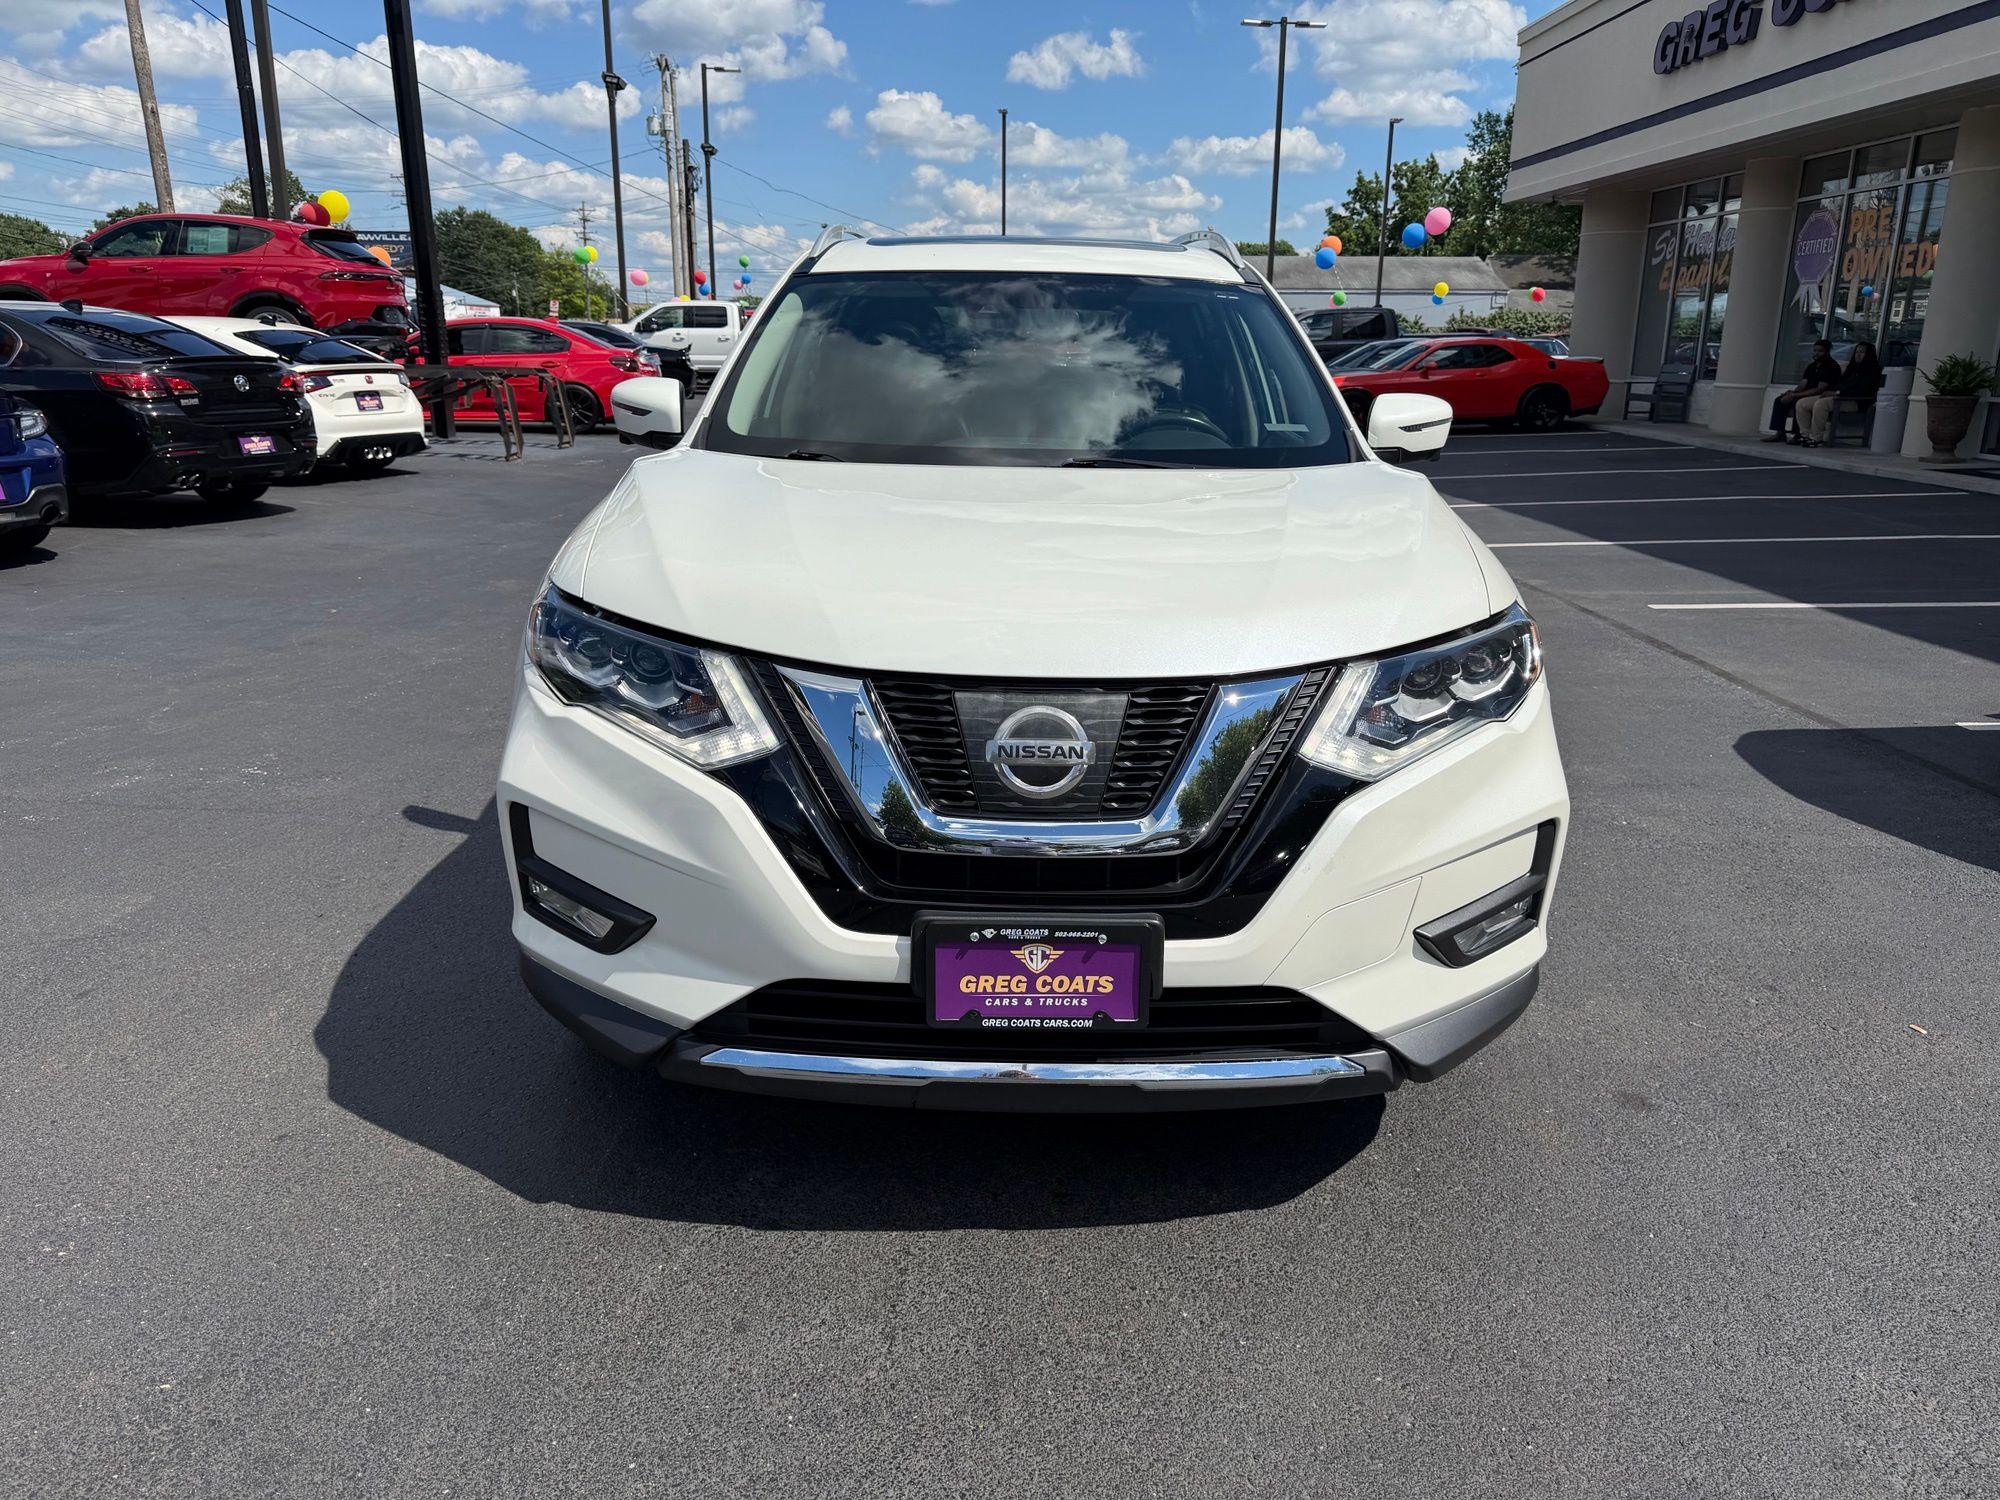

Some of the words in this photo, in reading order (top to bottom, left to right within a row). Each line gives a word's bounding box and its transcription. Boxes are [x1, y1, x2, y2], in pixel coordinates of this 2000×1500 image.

[1654, 0, 1763, 75] GREG
[1651, 229, 1675, 266] Se
[1797, 237, 1834, 256] CERTIFIED
[997, 745, 1084, 760] NISSAN
[1000, 928, 1022, 936] GREG
[1024, 928, 1049, 936] COATS
[959, 975, 1028, 993] GREG
[1036, 975, 1114, 993] COATS
[985, 997, 1019, 1006] CARS
[1025, 997, 1033, 1006] &
[1039, 997, 1088, 1006] TRUCKS
[982, 1018, 1009, 1028] GREG
[1010, 1018, 1041, 1028] COATS
[1043, 1019, 1093, 1028] CARS.COM
